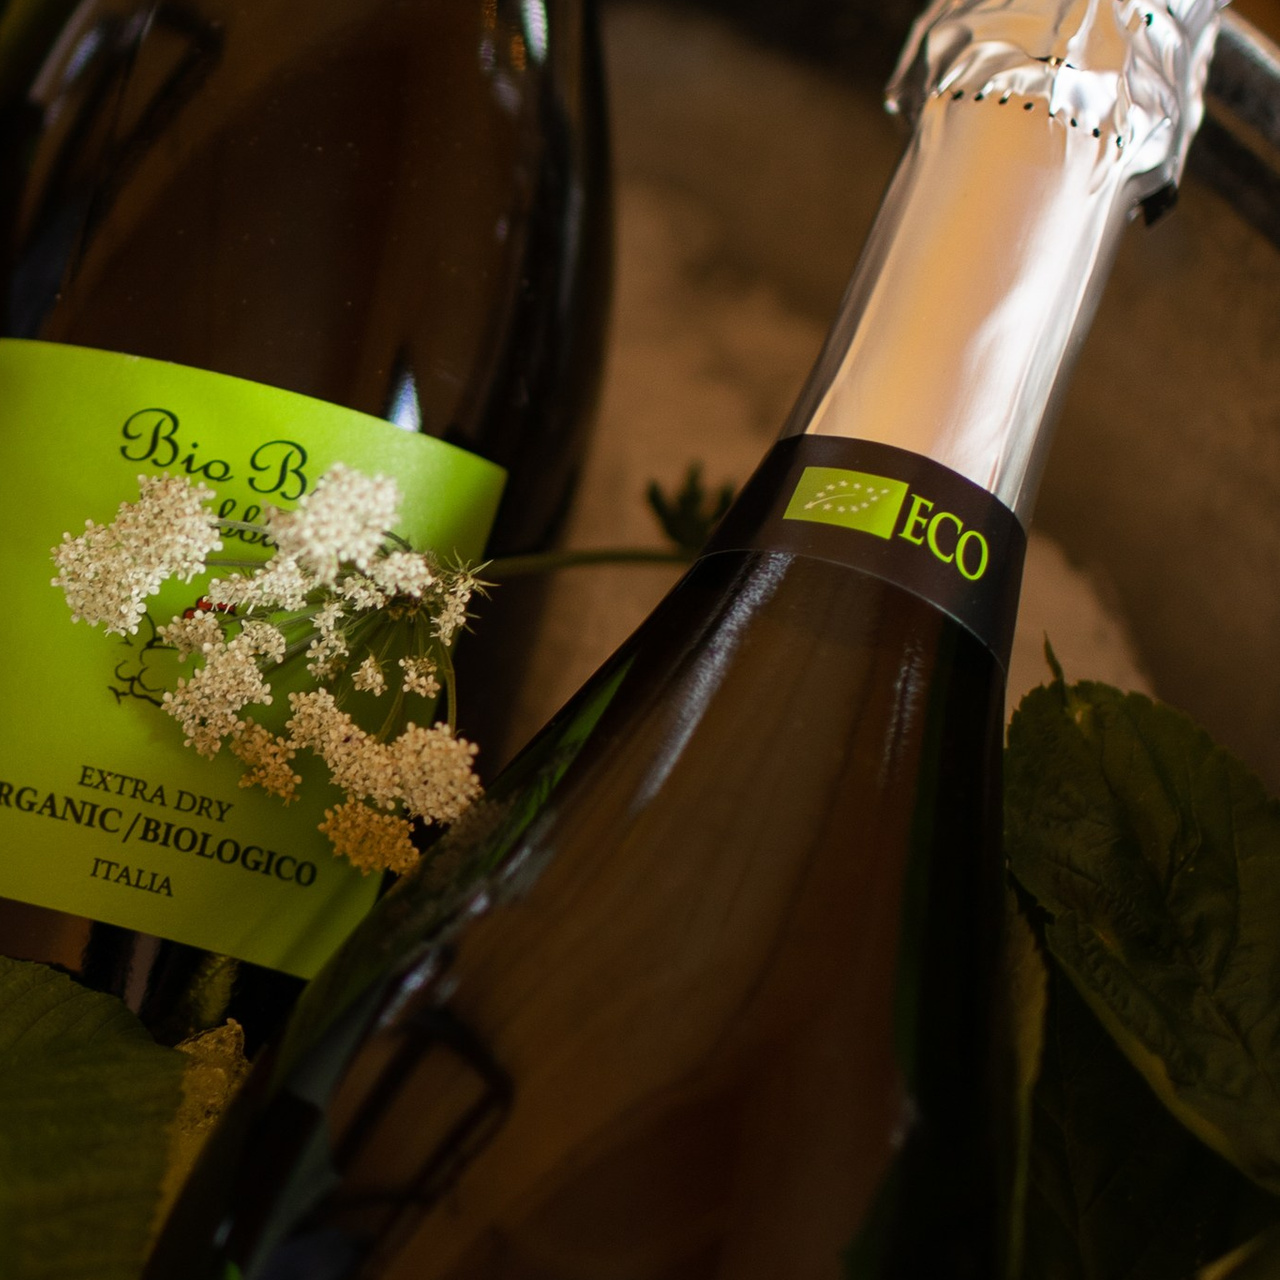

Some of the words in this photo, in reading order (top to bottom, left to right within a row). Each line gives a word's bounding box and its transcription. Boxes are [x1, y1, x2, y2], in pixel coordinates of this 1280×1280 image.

[120, 407, 235, 482] Bio
[898, 493, 989, 581] ECO
[78, 764, 168, 807] EXTRA
[174, 789, 234, 824] DRY
[89, 856, 174, 898] ITALIA
